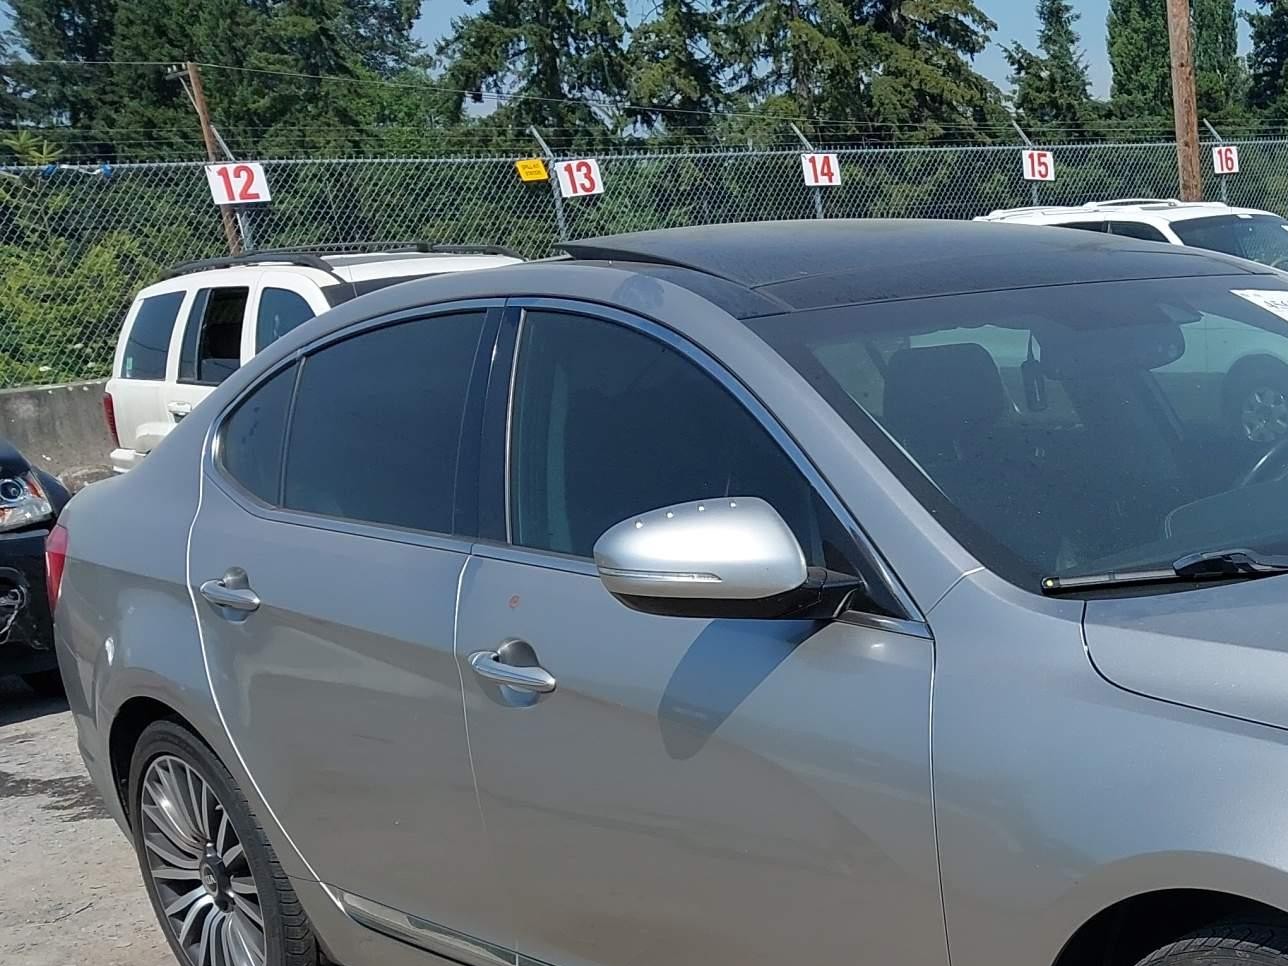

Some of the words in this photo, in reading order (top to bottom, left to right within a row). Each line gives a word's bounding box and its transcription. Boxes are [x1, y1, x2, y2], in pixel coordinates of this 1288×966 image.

[808, 155, 834, 183] 14
[1028, 152, 1048, 178] 15
[1217, 148, 1234, 172] 16
[216, 165, 260, 201] 12
[564, 161, 595, 194] 13
